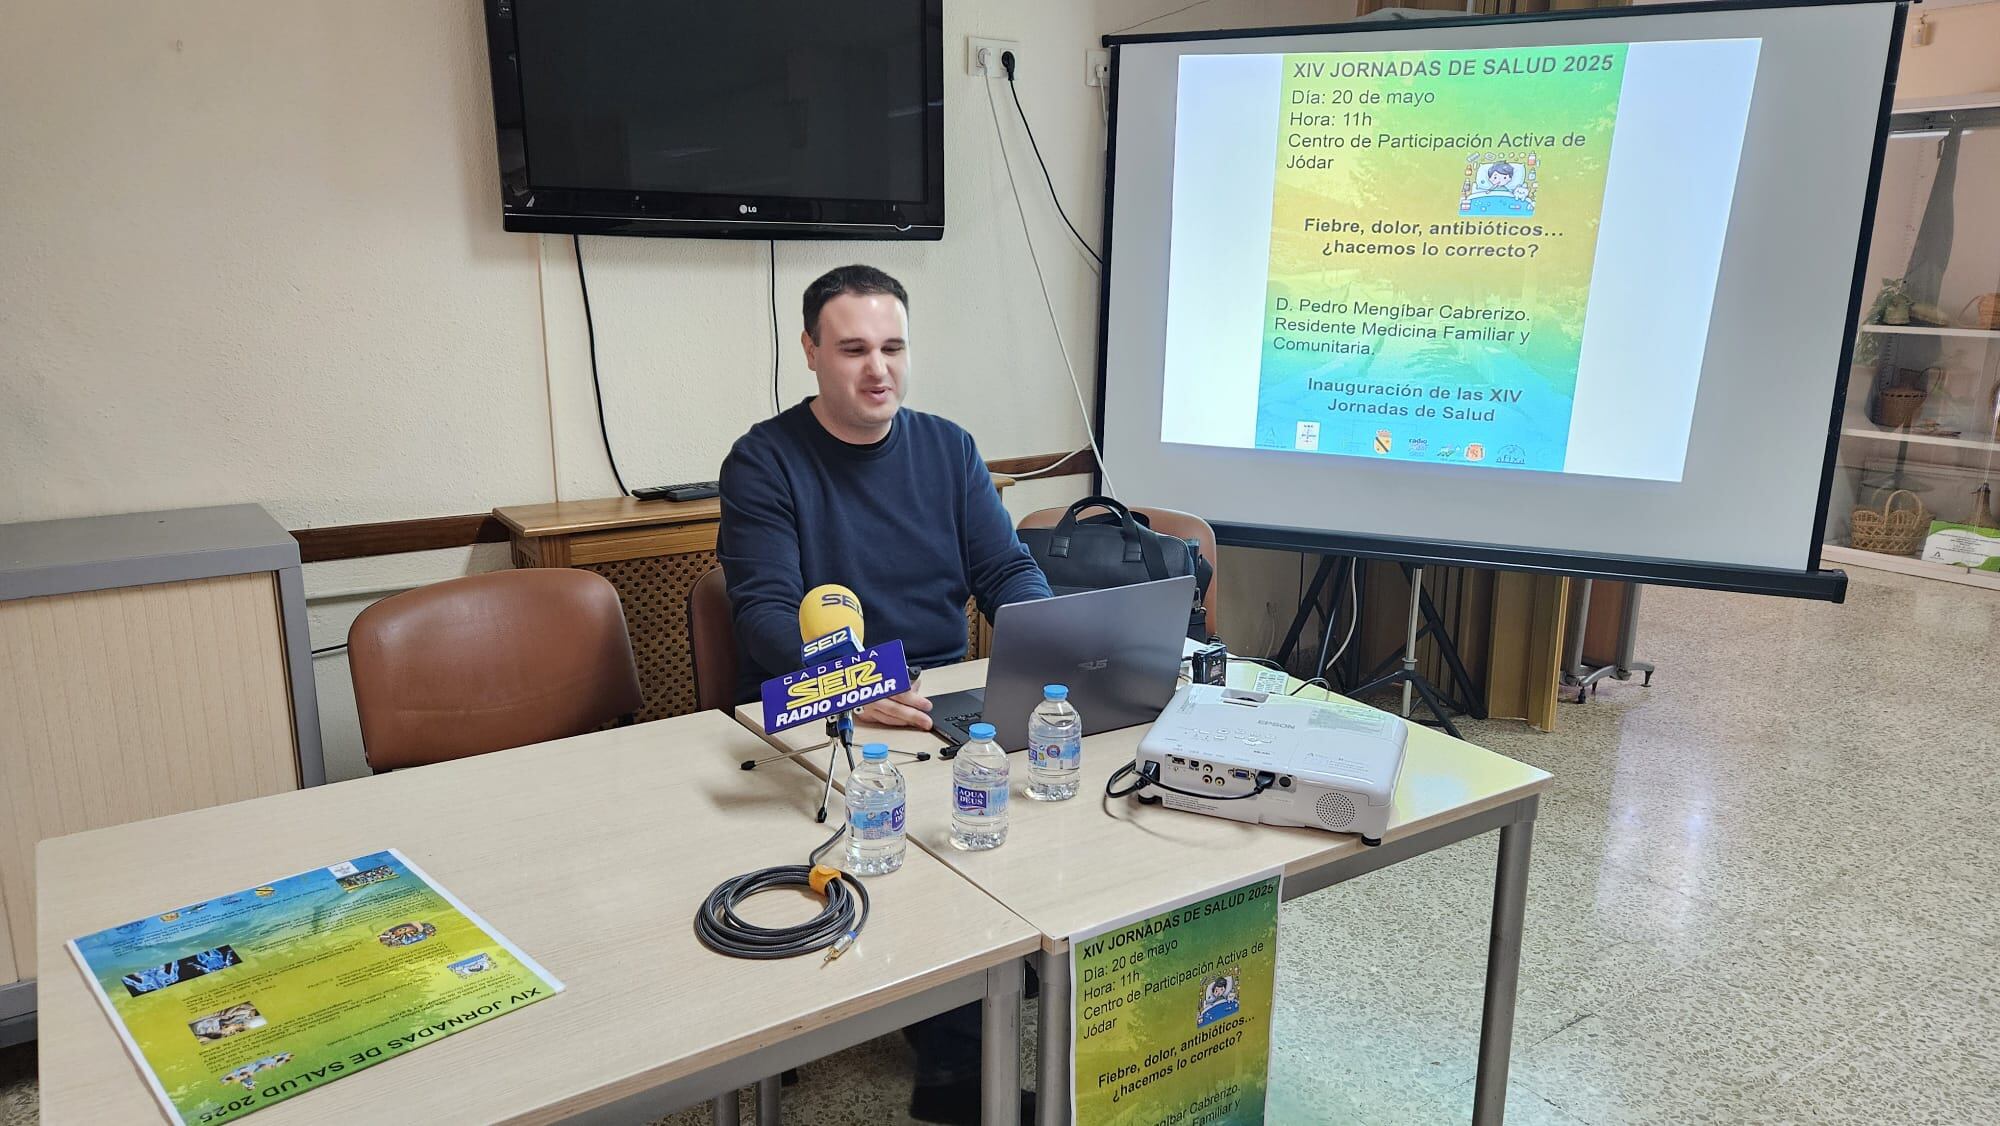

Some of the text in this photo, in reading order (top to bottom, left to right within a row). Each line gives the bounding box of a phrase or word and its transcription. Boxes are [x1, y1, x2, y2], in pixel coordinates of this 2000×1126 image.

[1293, 54, 1614, 79] XIV JORNADAS DE SALUD 2025
[1291, 89, 1435, 107] Día: 20 de mayo
[1289, 111, 1372, 127] Hora: 11h
[1287, 132, 1586, 152] Centro de Participación Activa de
[1286, 154, 1334, 170] Jódar
[1304, 218, 1365, 235] Fiebre,
[1371, 220, 1423, 237] dolor,
[1322, 240, 1539, 258] ¿hacemos lo correcto?
[1276, 297, 1531, 322] D. Pedro Mengíbar Cabrerizo.
[1274, 317, 1530, 345] Residente Medicina Familiar y
[1273, 337, 1375, 356] Comunitaria.
[1307, 377, 1523, 403] Inauguración de las XIV
[1327, 399, 1495, 422] Jornadas de Salud
[804, 629, 848, 657] SER
[783, 650, 879, 685] CADENA
[786, 660, 883, 710] SER
[775, 678, 897, 728] RADIO JODAR
[959, 788, 985, 799] AQUA
[960, 796, 983, 805] DEUS
[1083, 884, 1274, 960] XIV JORNADAS DE SALUD 2025
[1084, 939, 1178, 983] Día: 20 de mayo
[1083, 941, 1264, 1020] Centro de Participación Activa de
[1084, 969, 1140, 1002] Hora: 11h
[510, 987, 542, 1004] XIV
[387, 1001, 502, 1050] JORNADAS
[1083, 1017, 1118, 1040] Jódar
[349, 1046, 383, 1065] DE
[1098, 1063, 1141, 1088] Fiebre,
[1144, 1046, 1177, 1068] dolor,
[1112, 1030, 1243, 1103] ¿hacemos lo correcto?
[262, 1061, 345, 1098] SALUD
[199, 1096, 256, 1124] 2025
[1189, 1084, 1240, 1115] Cabrerizo.
[1192, 1098, 1241, 1126] Familiar y
